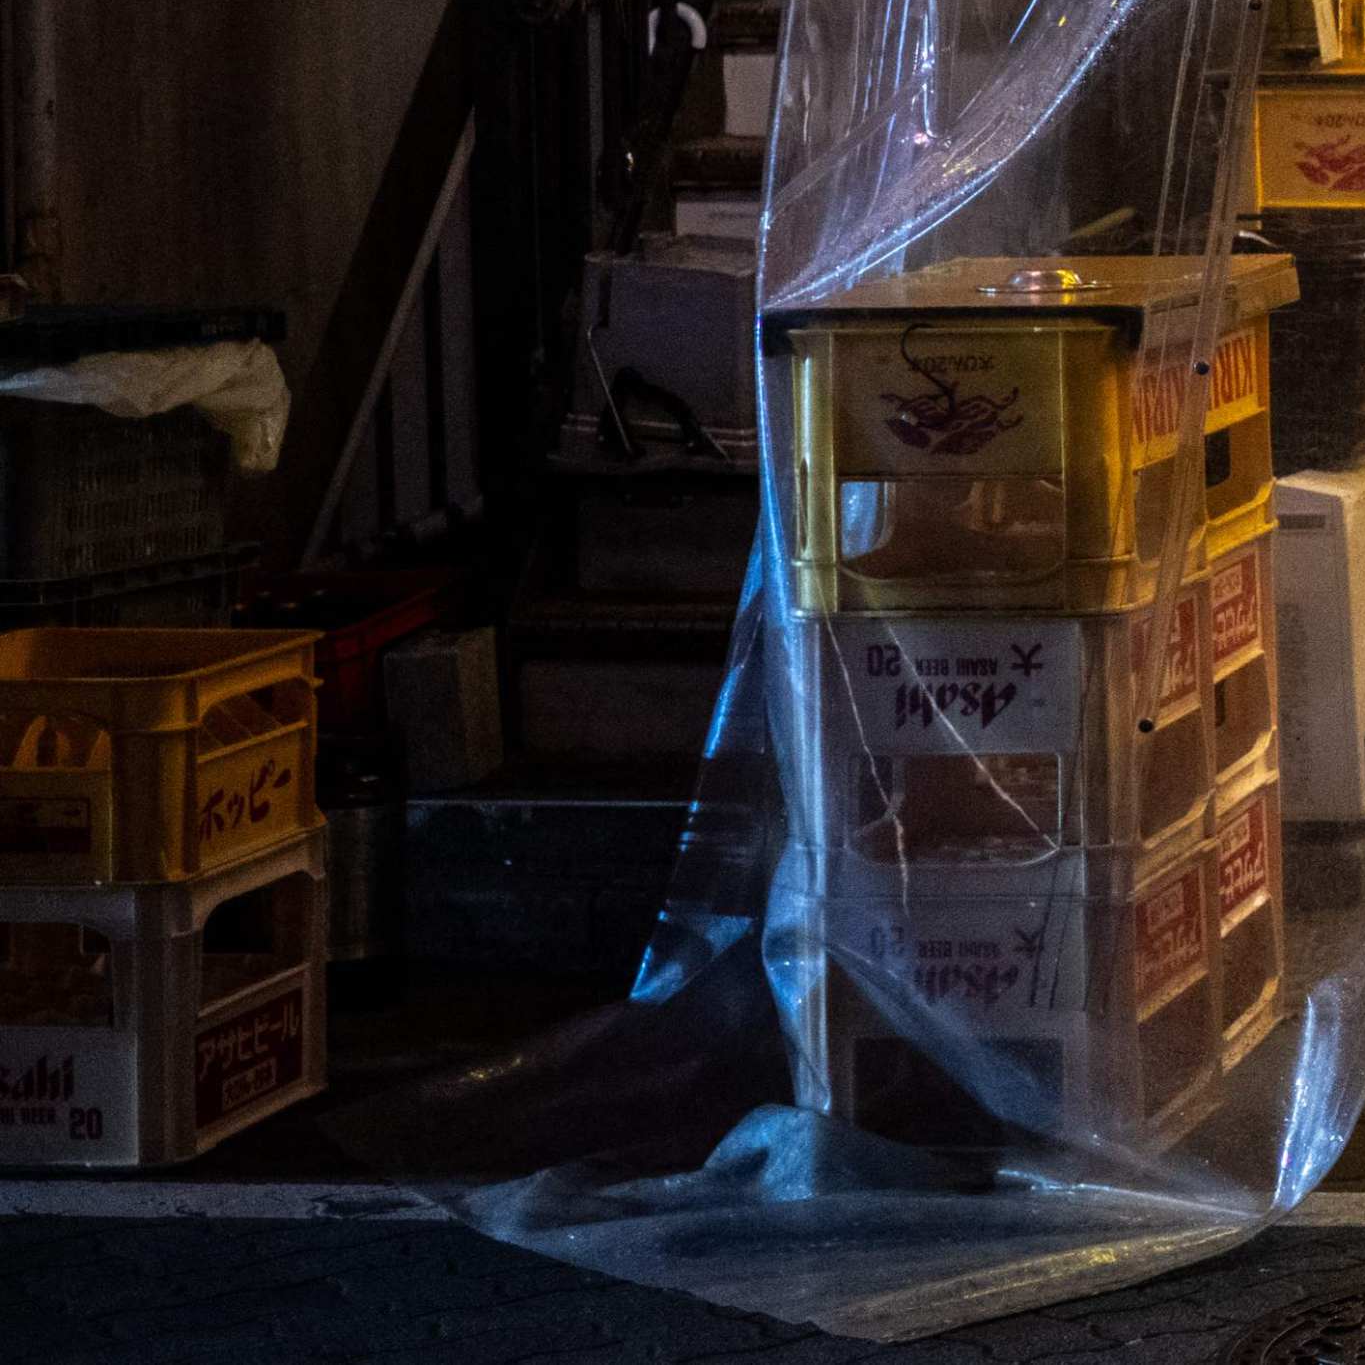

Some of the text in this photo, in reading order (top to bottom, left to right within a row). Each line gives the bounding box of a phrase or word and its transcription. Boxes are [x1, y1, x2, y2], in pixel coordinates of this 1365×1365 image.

[915, 657, 950, 677] BEER
[956, 657, 997, 678] ASAHI
[895, 682, 1016, 730] Asahi
[199, 759, 291, 842] ホッピー
[903, 963, 1019, 1008] Asahi
[198, 1000, 301, 1083] アサヒビール
[70, 1107, 102, 1140] 20
